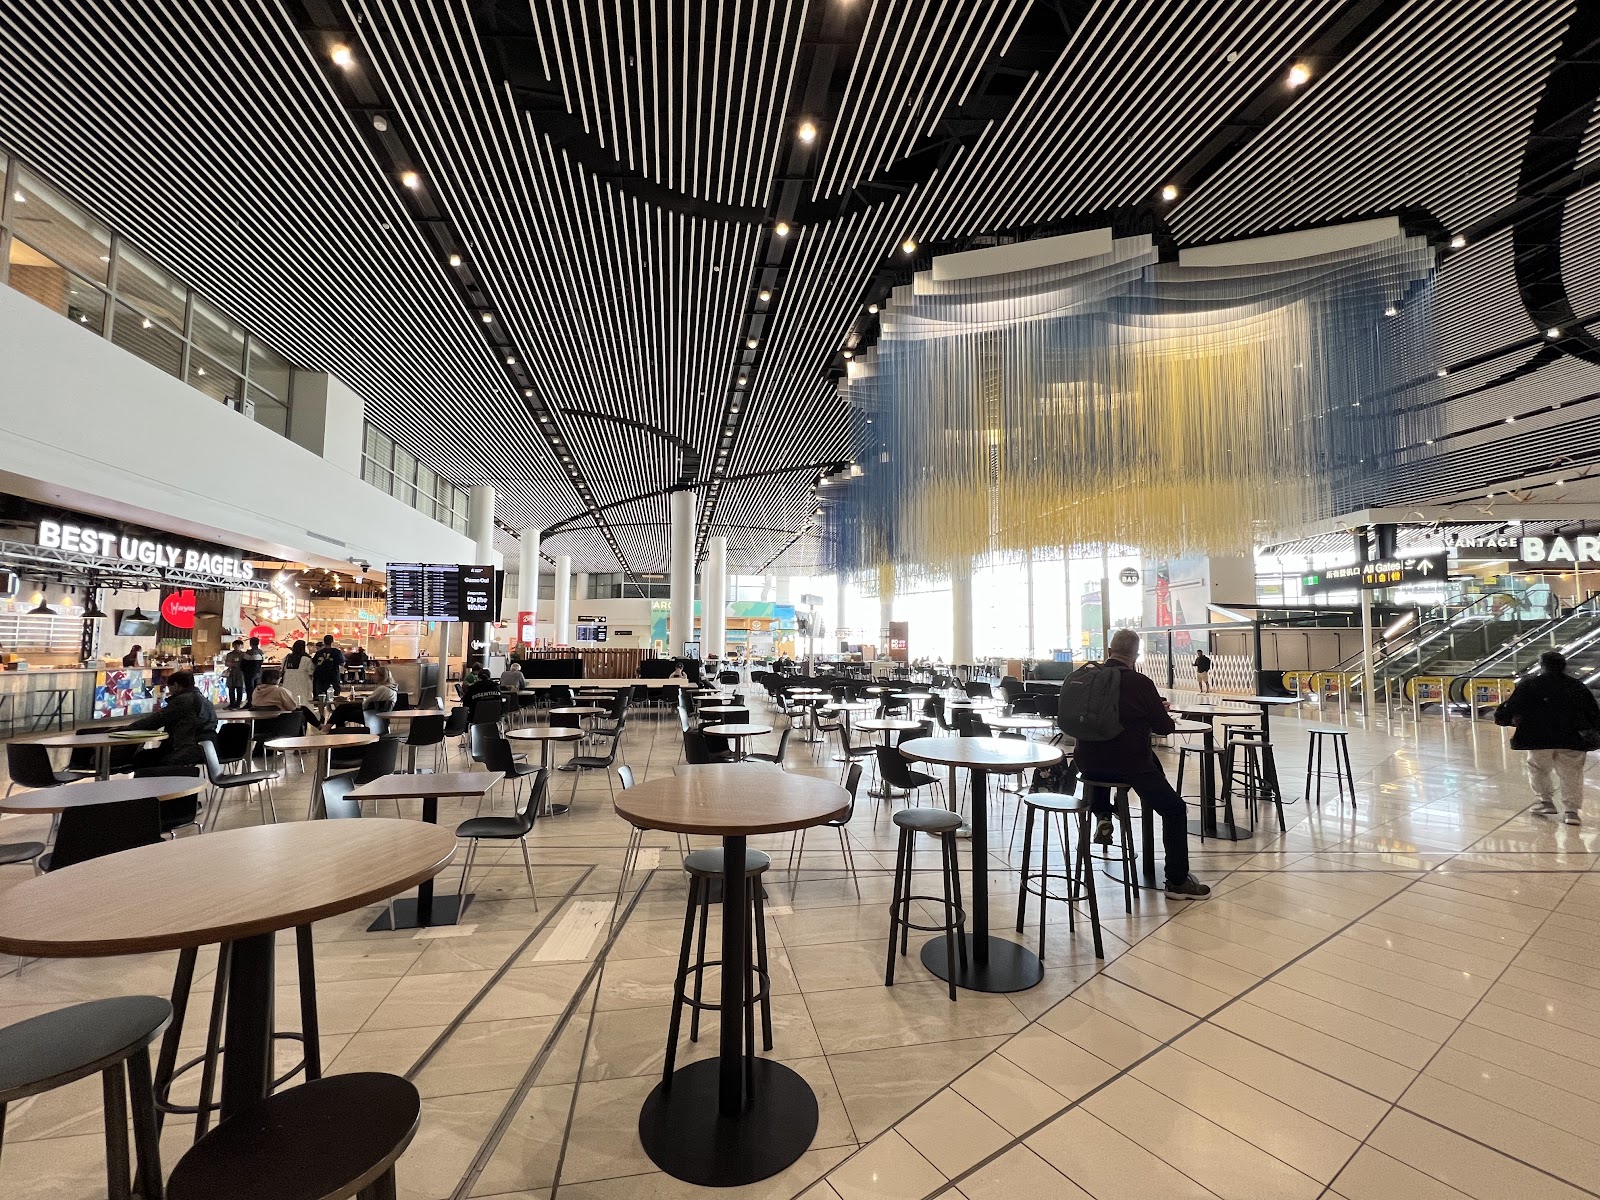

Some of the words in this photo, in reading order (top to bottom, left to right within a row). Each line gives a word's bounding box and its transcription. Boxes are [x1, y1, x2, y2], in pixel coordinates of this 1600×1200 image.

[39, 520, 116, 557] BEST
[120, 536, 181, 568] UGLY
[184, 549, 254, 579] BAGELS
[1445, 537, 1518, 548] VANTAGE
[1522, 536, 1600, 562] BAR
[1363, 563, 1374, 575] All
[1375, 561, 1401, 573] Gates
